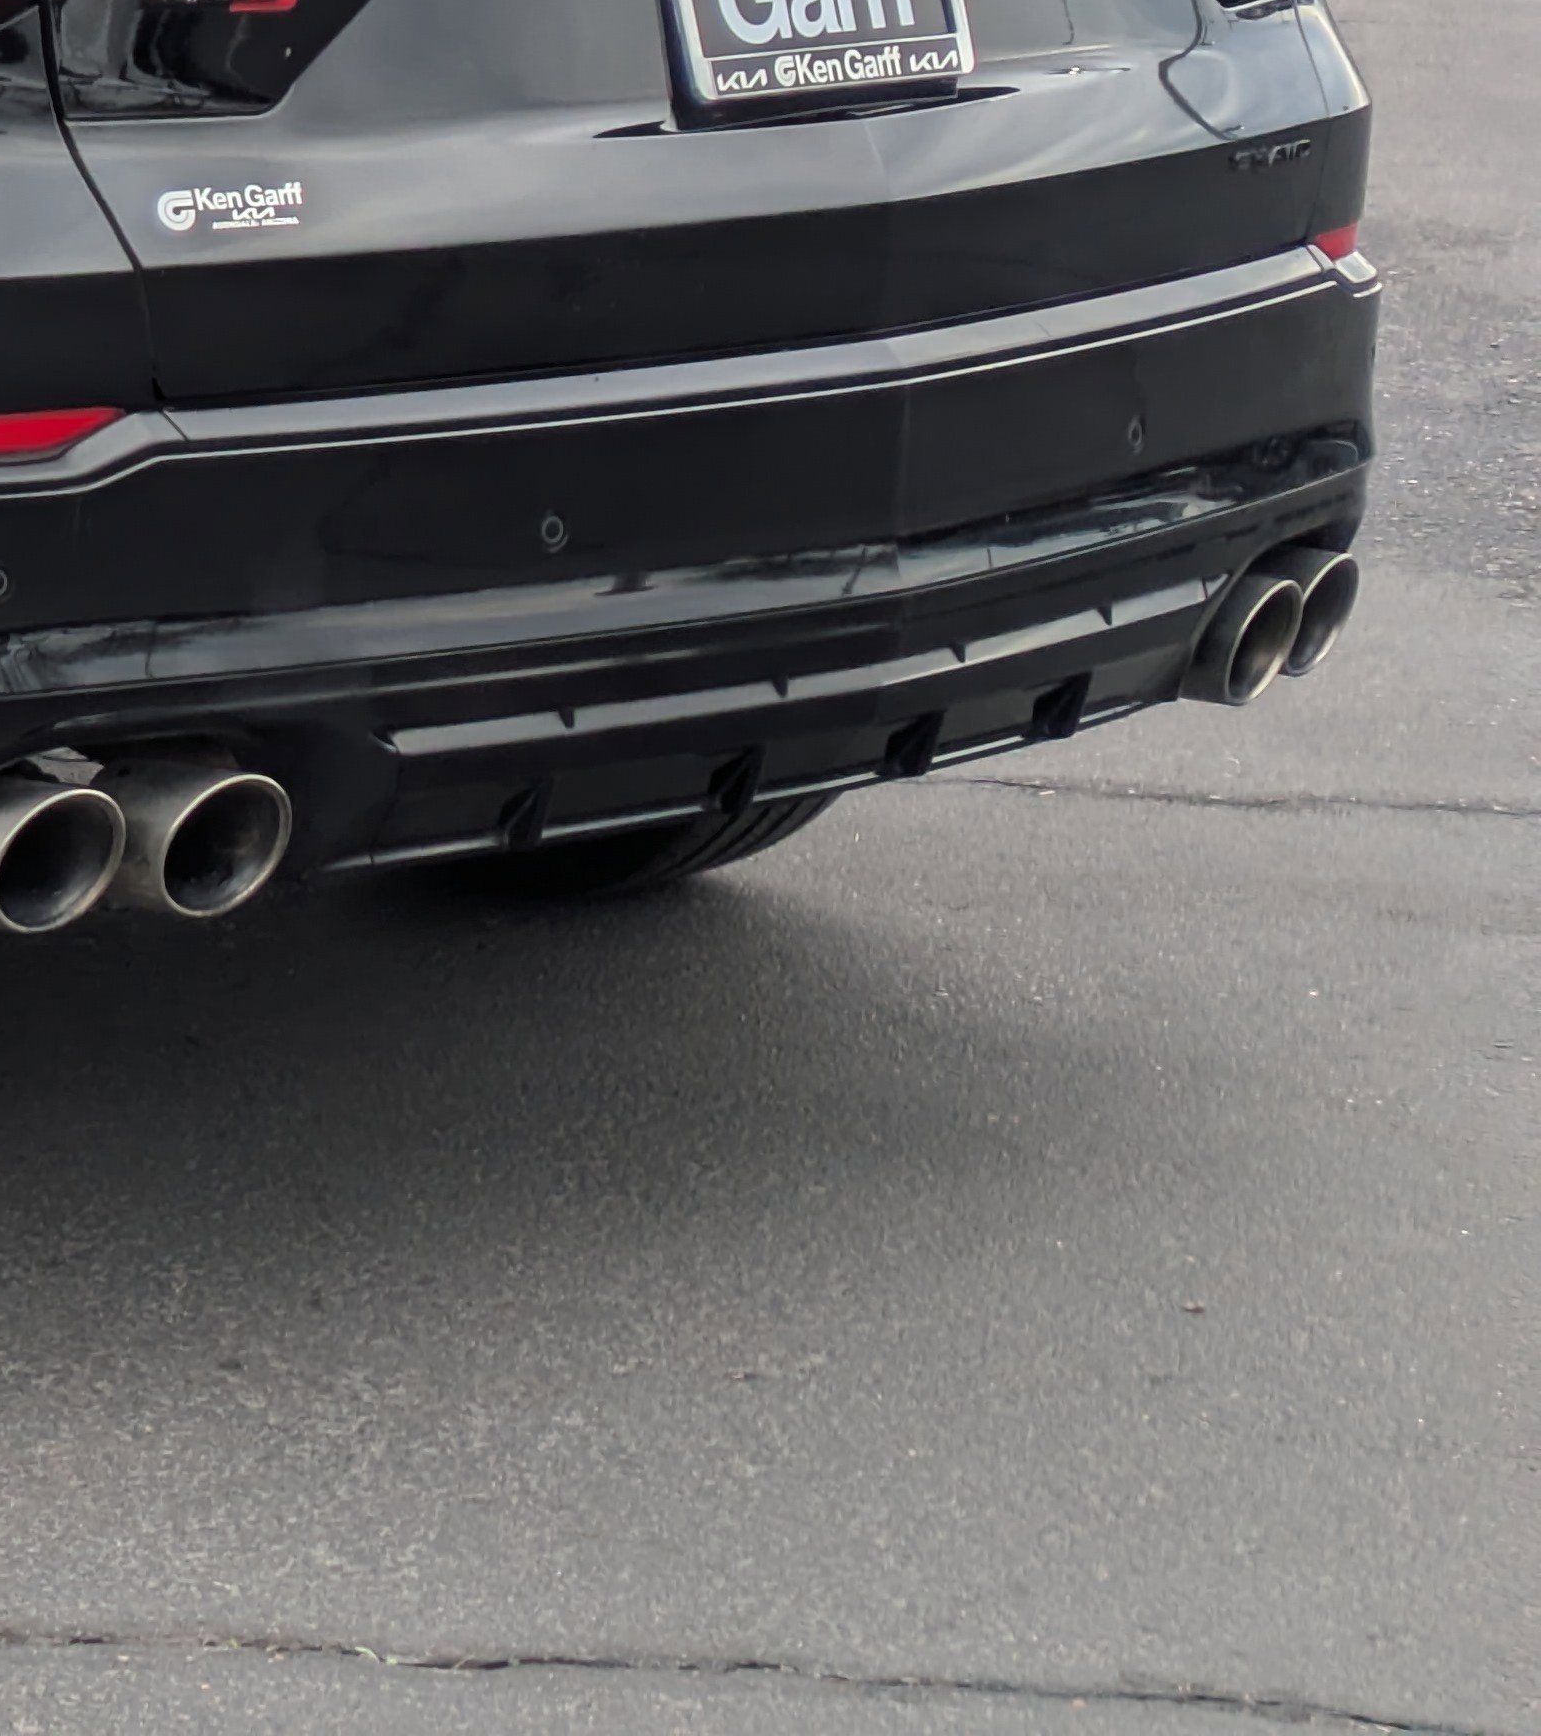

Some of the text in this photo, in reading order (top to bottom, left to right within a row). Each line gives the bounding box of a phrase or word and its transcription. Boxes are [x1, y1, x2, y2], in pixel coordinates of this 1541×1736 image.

[795, 53, 844, 86] Ken
[843, 45, 902, 81] Garff
[193, 186, 244, 211] Ken
[244, 181, 303, 207] Garff
